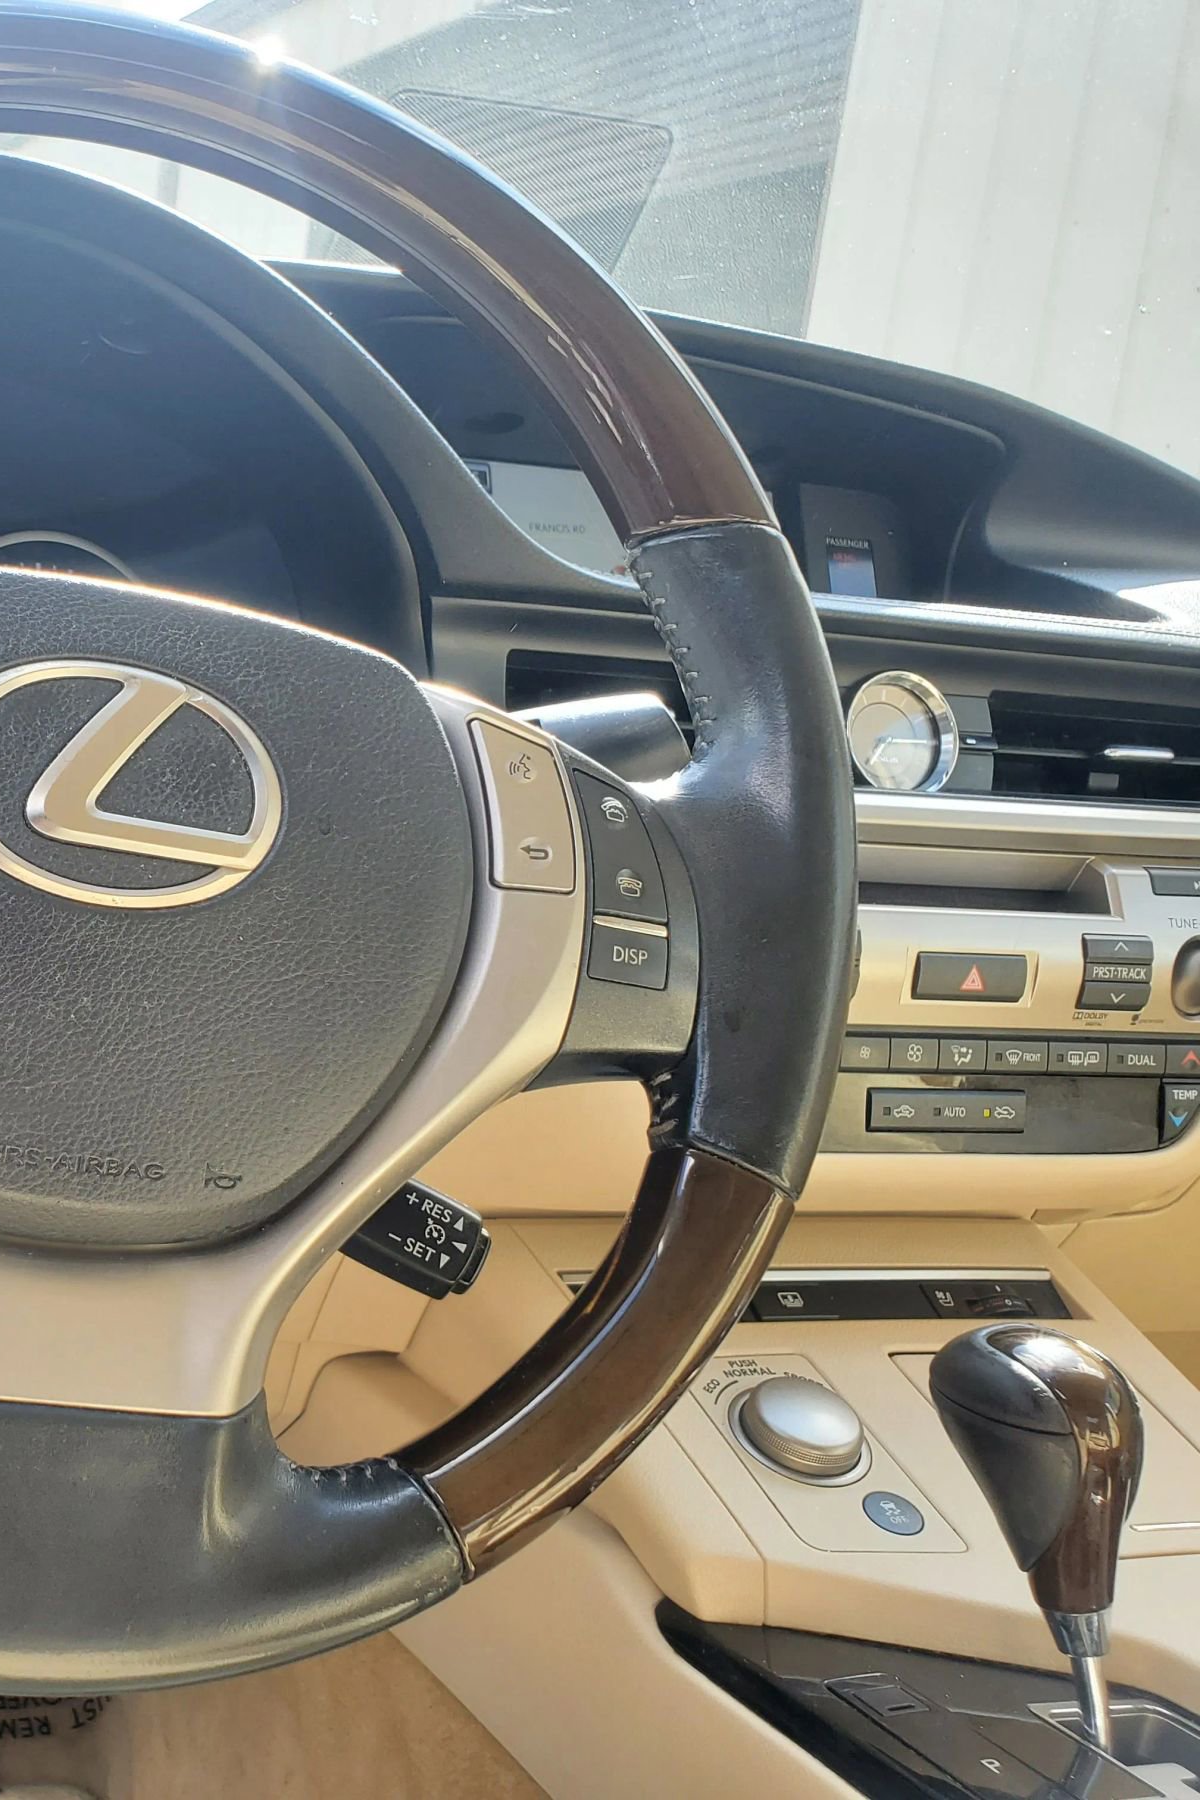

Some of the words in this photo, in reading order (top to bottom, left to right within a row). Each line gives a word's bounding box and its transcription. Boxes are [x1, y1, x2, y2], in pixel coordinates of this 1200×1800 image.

[529, 522, 570, 534] FRANCIS
[826, 536, 870, 550] PASSENGER
[612, 945, 648, 966] DISP
[1022, 1050, 1041, 1062] FRONT
[1127, 1054, 1157, 1066] DUAL
[1172, 1089, 1199, 1100] TEMP
[943, 1106, 967, 1117] AUTO
[421, 1199, 453, 1223] RES
[403, 1237, 437, 1262] SET
[728, 1359, 758, 1368] PUSH
[722, 1367, 777, 1379] NORMAL
[702, 1378, 721, 1394] ECO
